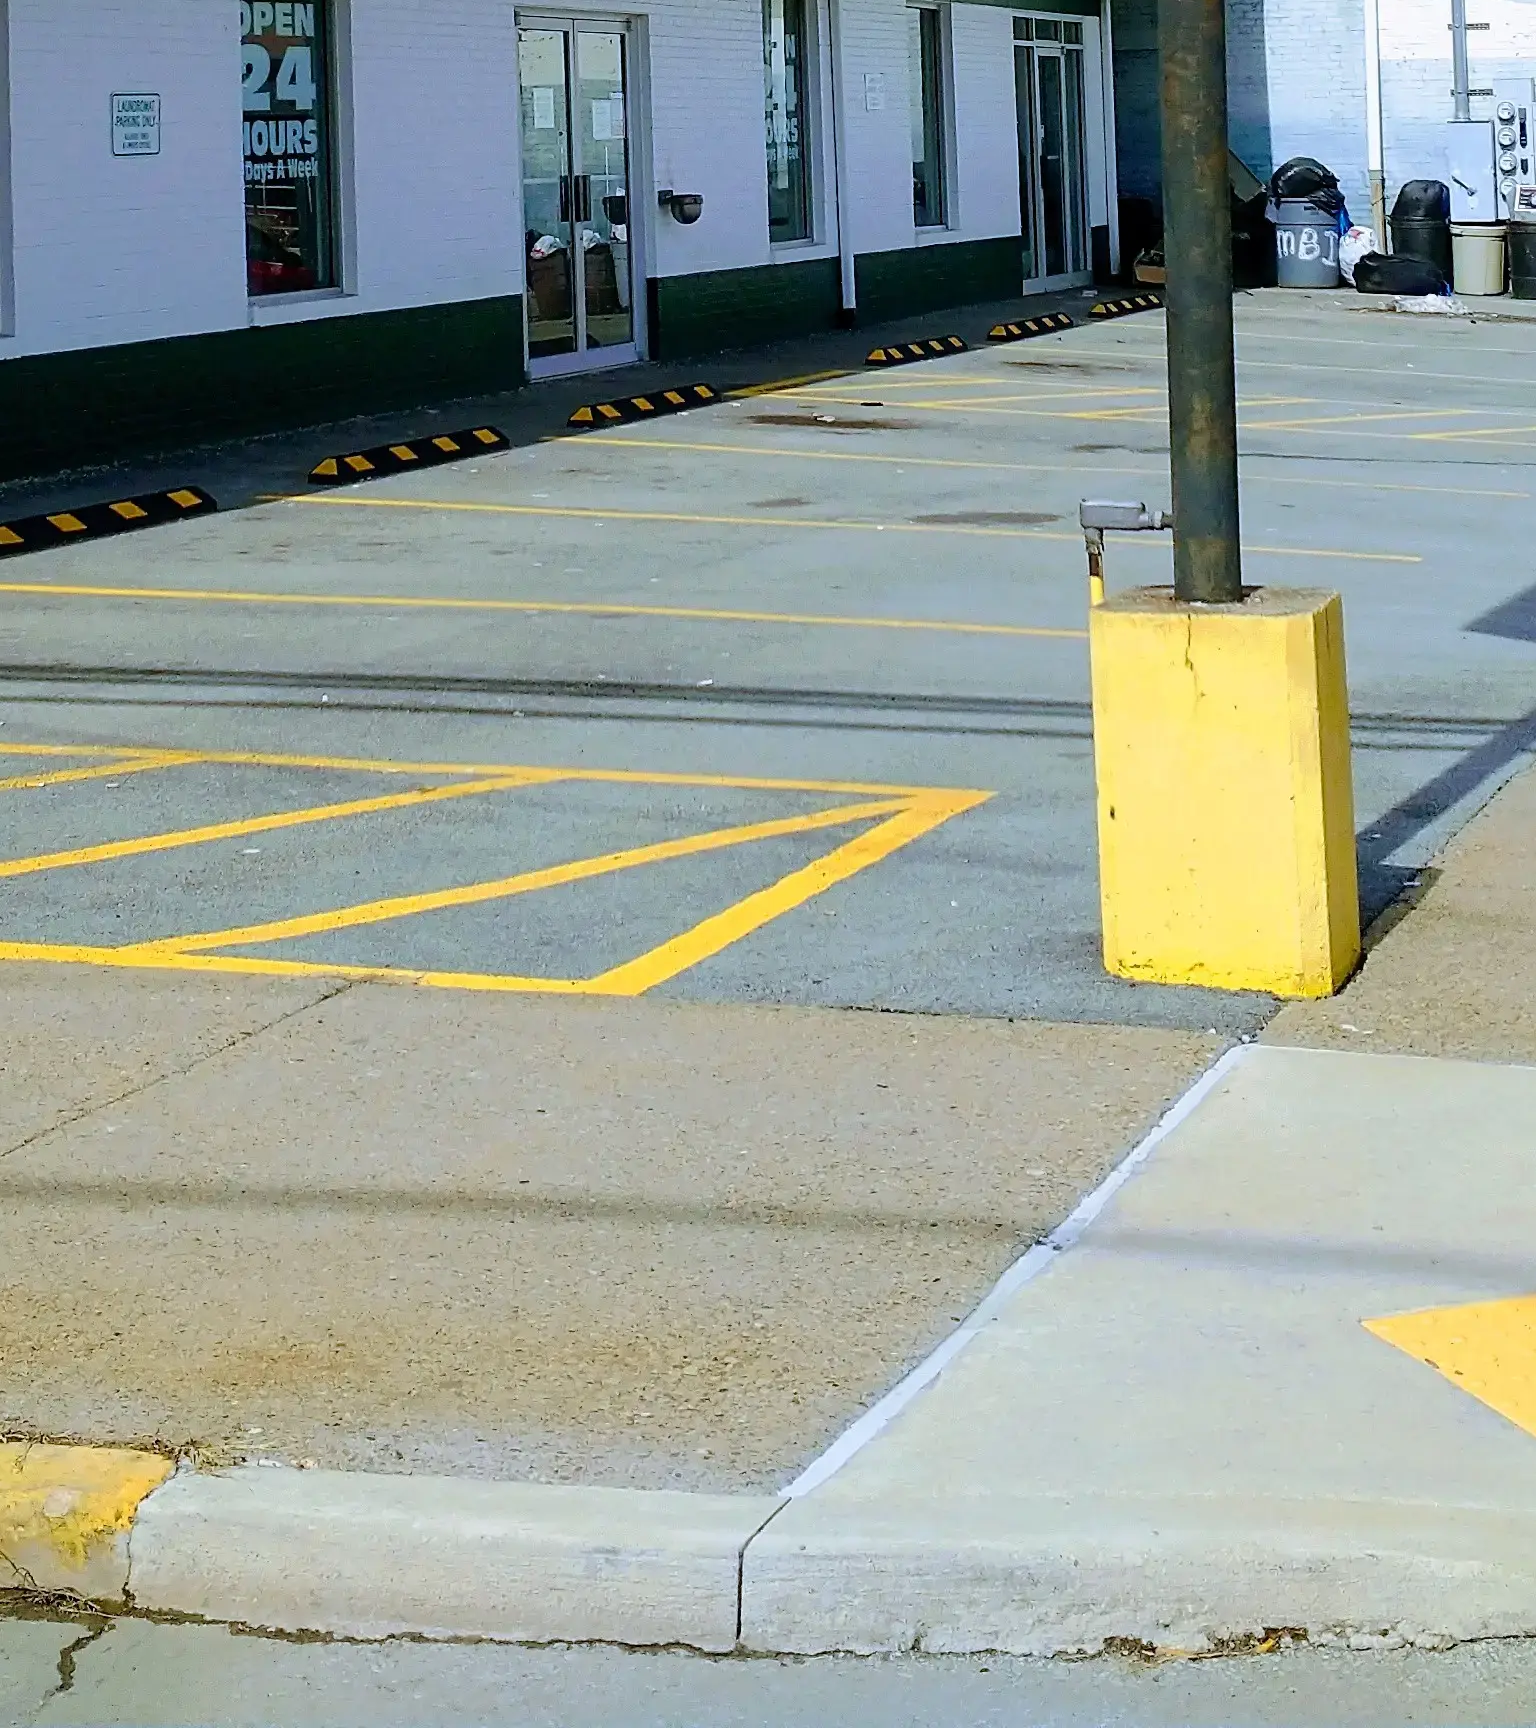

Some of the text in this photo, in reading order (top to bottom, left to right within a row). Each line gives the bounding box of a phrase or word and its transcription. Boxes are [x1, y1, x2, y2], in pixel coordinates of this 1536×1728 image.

[240, 0, 314, 37] OPEN
[241, 43, 317, 111] 24
[245, 156, 319, 184] Days A Week
